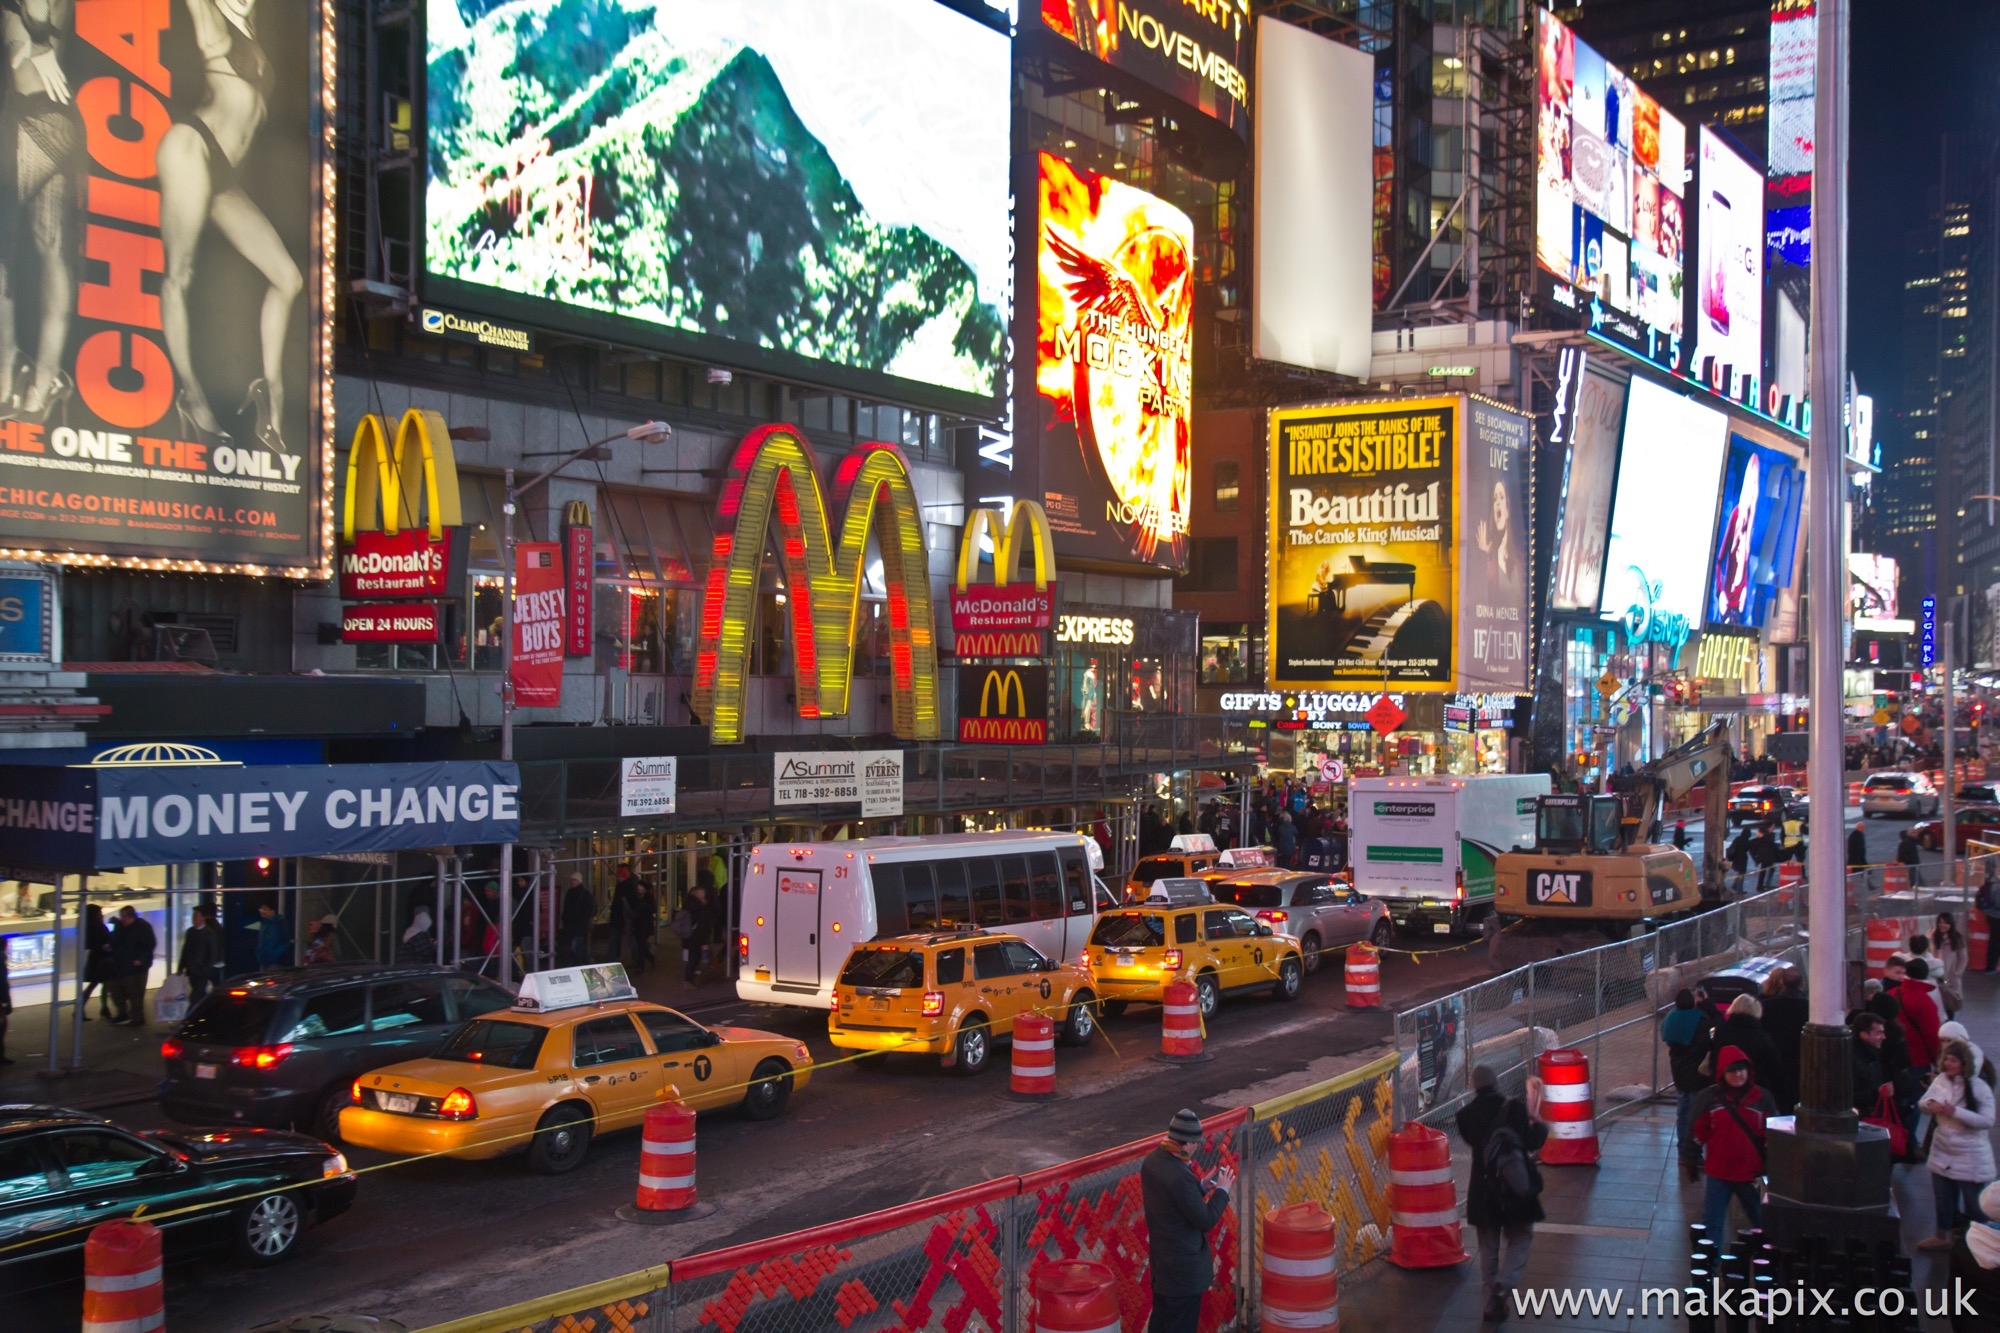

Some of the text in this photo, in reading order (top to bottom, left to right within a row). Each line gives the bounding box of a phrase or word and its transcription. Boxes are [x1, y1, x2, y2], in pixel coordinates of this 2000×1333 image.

[1118, 1, 1247, 108] NOVEMBER
[1087, 309, 1121, 334] THE
[478, 334, 529, 351] SPECTACOLOR
[1431, 367, 1471, 376] LAMAR
[1334, 421, 1361, 438] JOINS
[1361, 420, 1377, 436] THE
[1379, 417, 1409, 435] RANKS
[1410, 416, 1423, 433] OF
[1423, 415, 1441, 432] THE
[1475, 411, 1523, 437] SEE BROADWAY'S
[1480, 427, 1519, 450] BIGGEST STAR
[51, 426, 133, 463] ONE
[137, 436, 208, 470] THE
[213, 446, 301, 481] ONLY
[1490, 447, 1509, 472] LIVE
[95, 463, 150, 479] AMERICAN
[150, 469, 194, 484] MUSICAL
[195, 474, 208, 484] IN
[208, 476, 262, 491] BROADWAY
[263, 481, 302, 494] HISTORY
[0, 487, 277, 527] CHICAGOTHEMUSICAL.COM
[1289, 481, 1440, 527] Beautiful
[1290, 524, 1440, 546] The Carole King Musical
[342, 551, 443, 574] McDonald's
[357, 575, 425, 590] Restaurant
[575, 533, 588, 649] OPEN 24 HOURS
[513, 588, 566, 624] JERSEY
[955, 597, 1048, 615] McDonald's
[1476, 604, 1519, 621] IDINA MENZEL
[344, 616, 434, 632] OPEN 24 HOURS
[970, 615, 1032, 626] Restaurant
[1056, 615, 1134, 646] EXPRESS
[522, 621, 561, 653] BOYS
[1473, 625, 1522, 664] IF/THEN
[1695, 632, 1751, 679] FOREVER
[1220, 693, 1282, 711] GIFTS
[1276, 720, 1306, 729] Canon
[1312, 721, 1342, 730] SONY
[1307, 710, 1326, 721] NY
[636, 760, 671, 775] Summit
[795, 760, 856, 777] Summit
[865, 765, 900, 778] EVEREST
[627, 797, 670, 807] 718.392.6858
[779, 789, 791, 800] TEL
[794, 786, 858, 799] 718-392-6858
[102, 784, 519, 840] MONEY CHANGE
[1376, 804, 1435, 815] enterprise
[834, 866, 849, 879] 31
[1536, 873, 1581, 903] CAT
